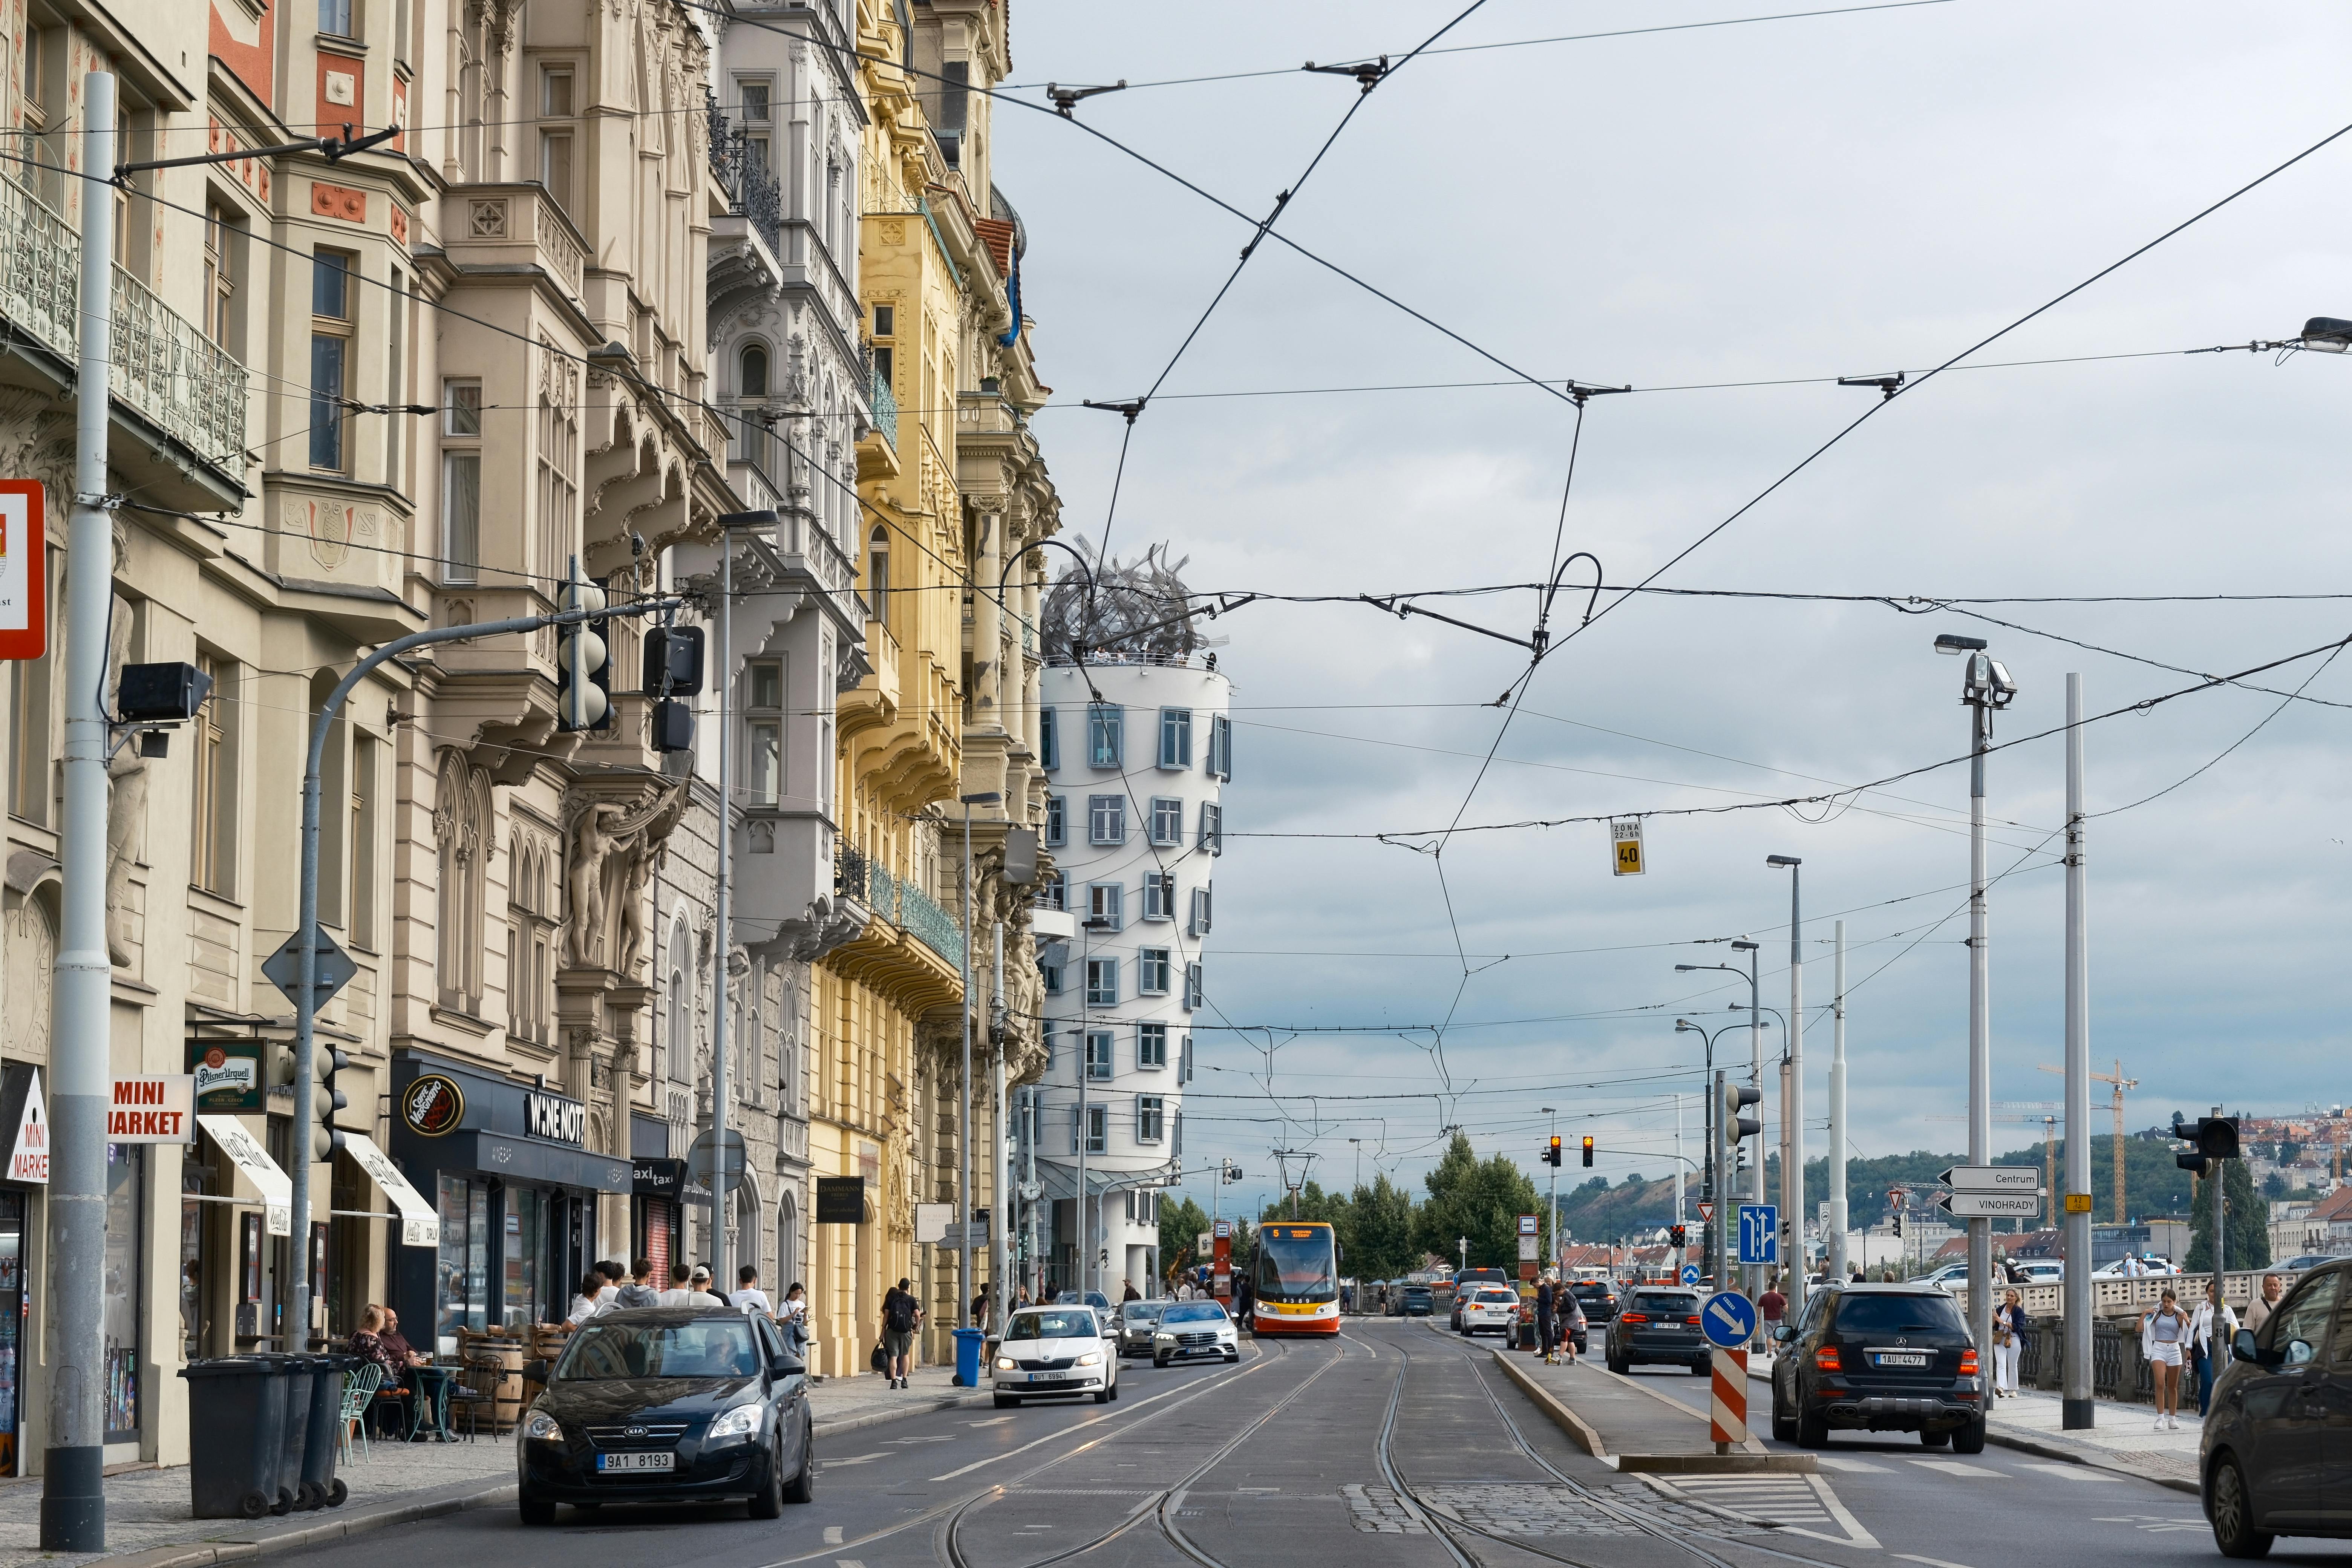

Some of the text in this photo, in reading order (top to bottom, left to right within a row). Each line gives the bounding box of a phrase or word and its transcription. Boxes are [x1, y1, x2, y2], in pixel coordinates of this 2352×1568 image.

[1619, 848, 1637, 863] 40
[199, 1067, 249, 1087] Pilsner Urquell
[114, 1081, 165, 1104] MINI
[410, 1080, 441, 1124] VERGNANO
[424, 1090, 451, 1131] 1882
[561, 1101, 585, 1144] NOT?
[25, 1124, 44, 1147] MINI
[632, 1166, 652, 1179] axi
[652, 1174, 673, 1186] taxi
[1996, 1174, 2035, 1183] Centrum
[1979, 1200, 2034, 1210] VINOHRADY
[1882, 1355, 1897, 1363] 1AU
[608, 1454, 668, 1467] 9A1 8193
